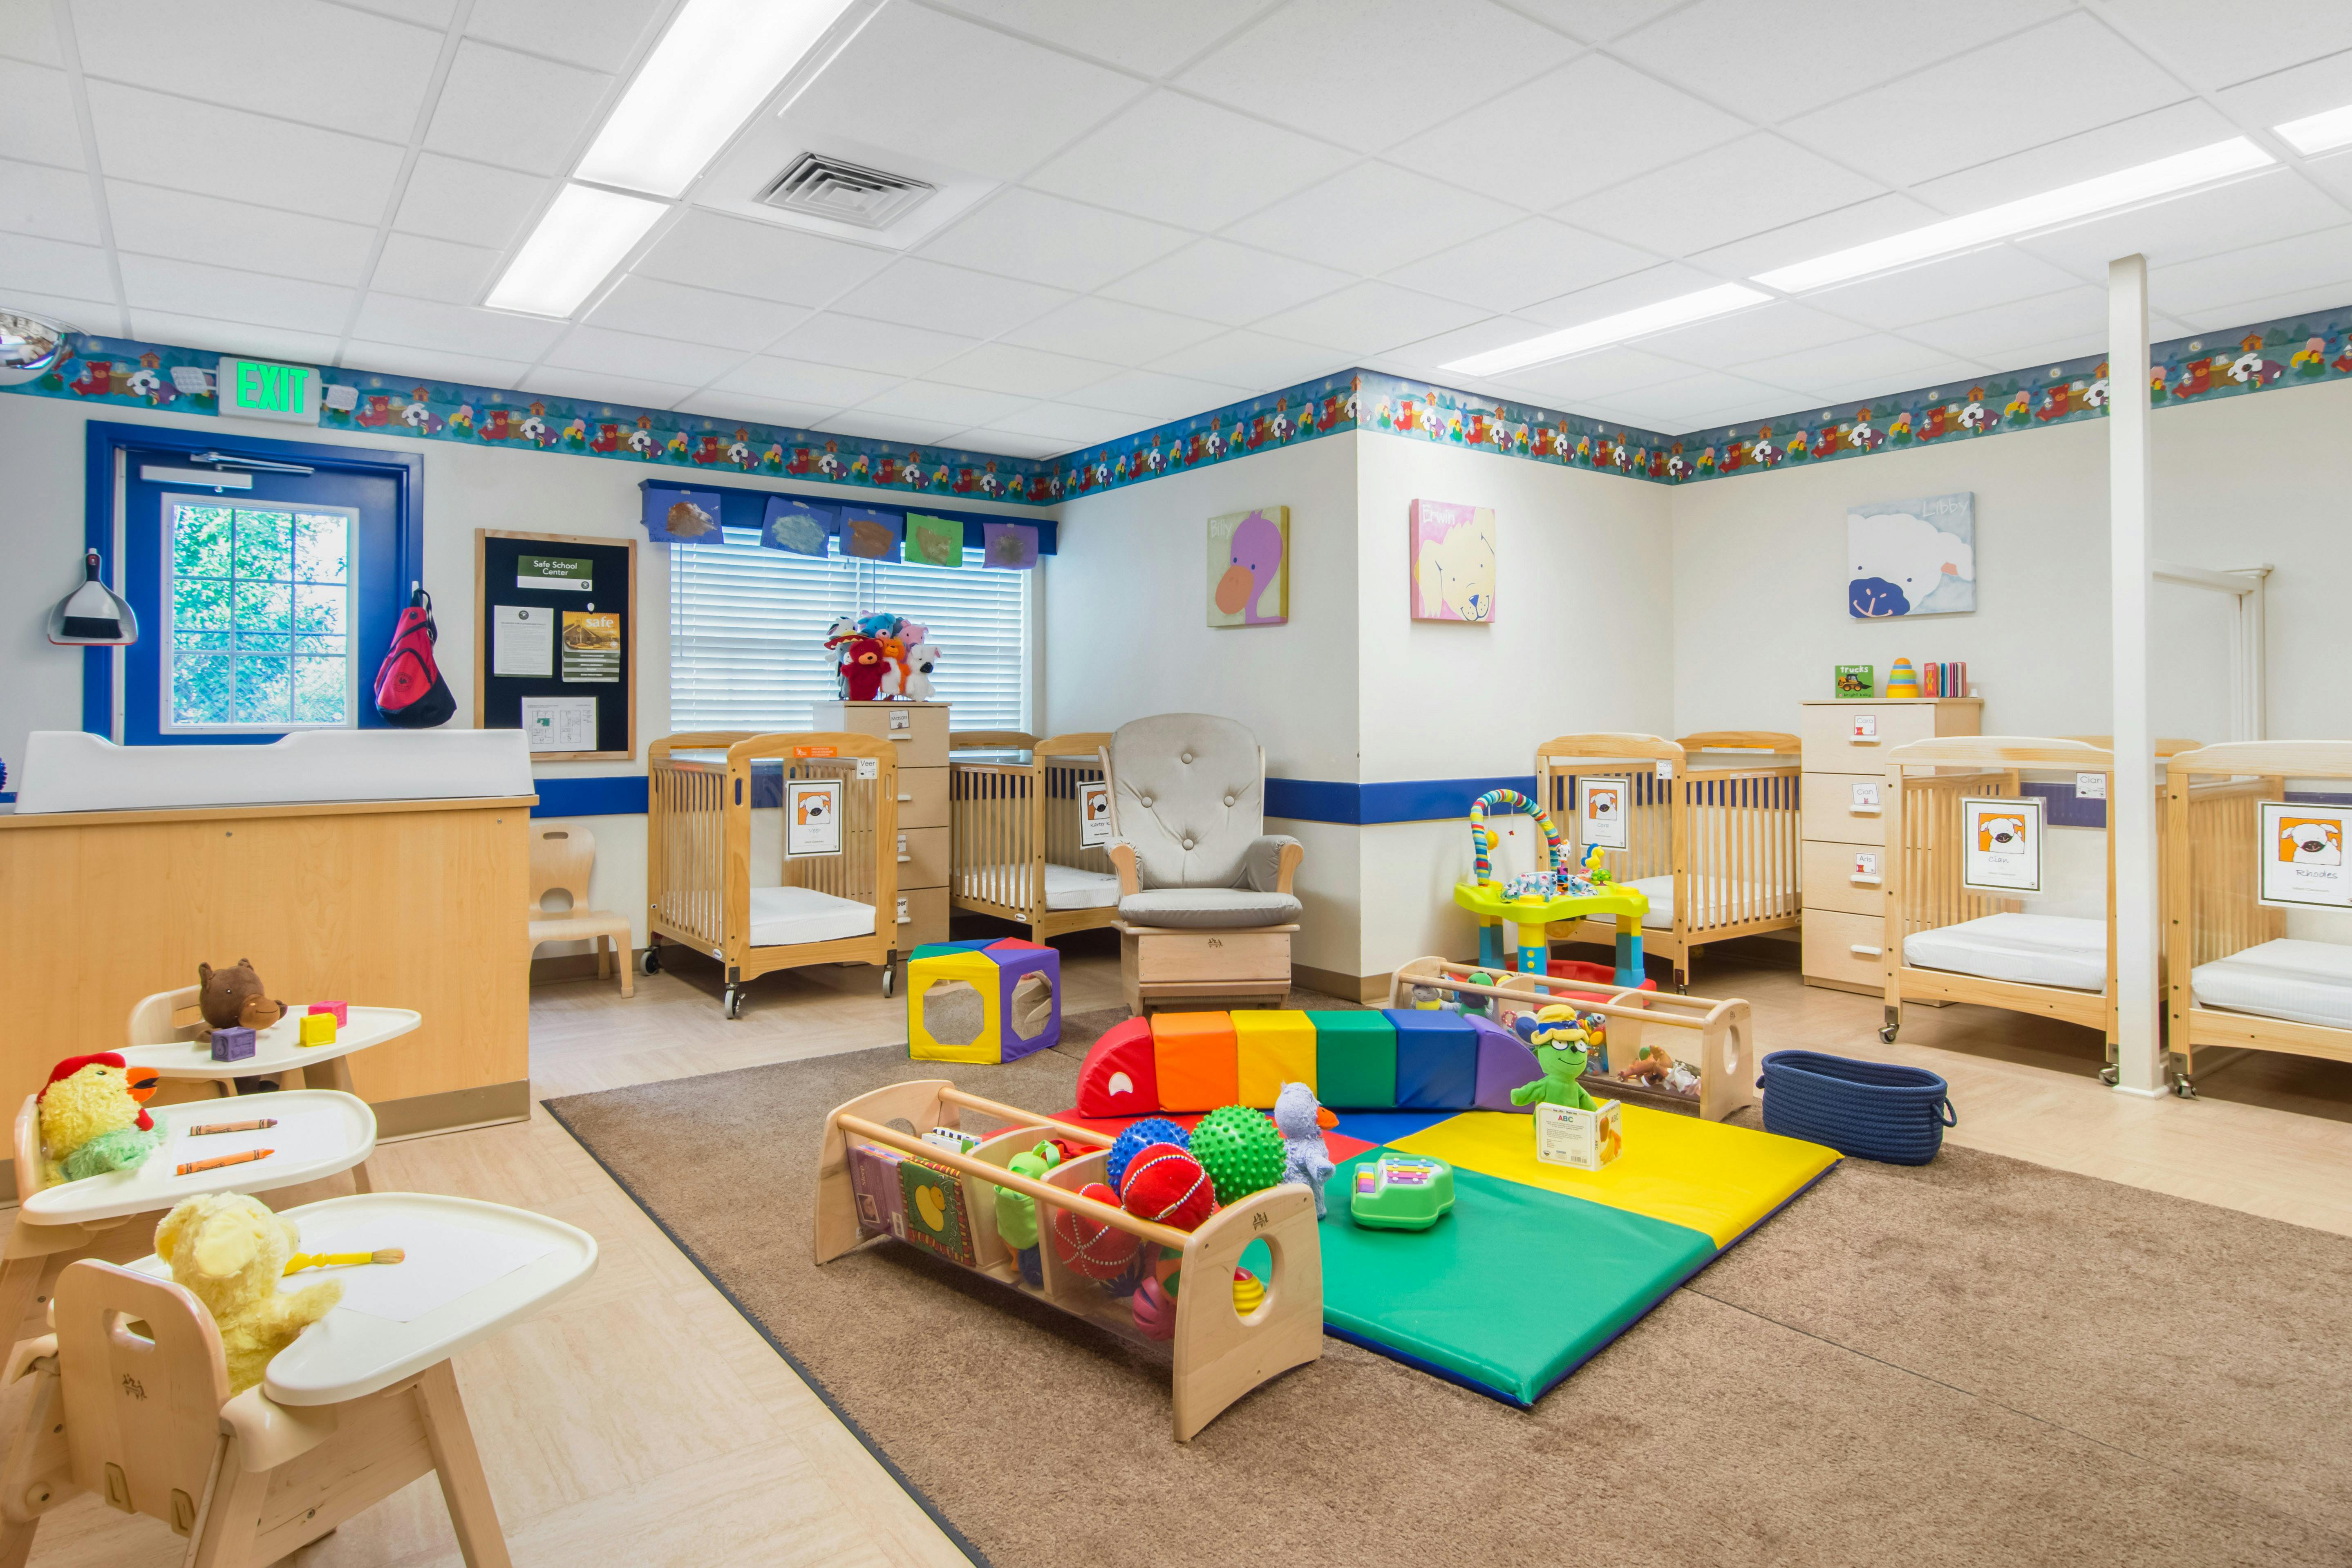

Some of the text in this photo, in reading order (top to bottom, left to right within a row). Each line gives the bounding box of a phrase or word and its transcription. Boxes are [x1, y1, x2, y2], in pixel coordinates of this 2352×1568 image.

[237, 362, 308, 414] EXIT
[1423, 503, 1455, 525] Erwin
[1922, 499, 1969, 517] Libby
[1210, 519, 1232, 539] Billy
[586, 616, 613, 628] safe
[2296, 869, 2338, 879] Rhodes
